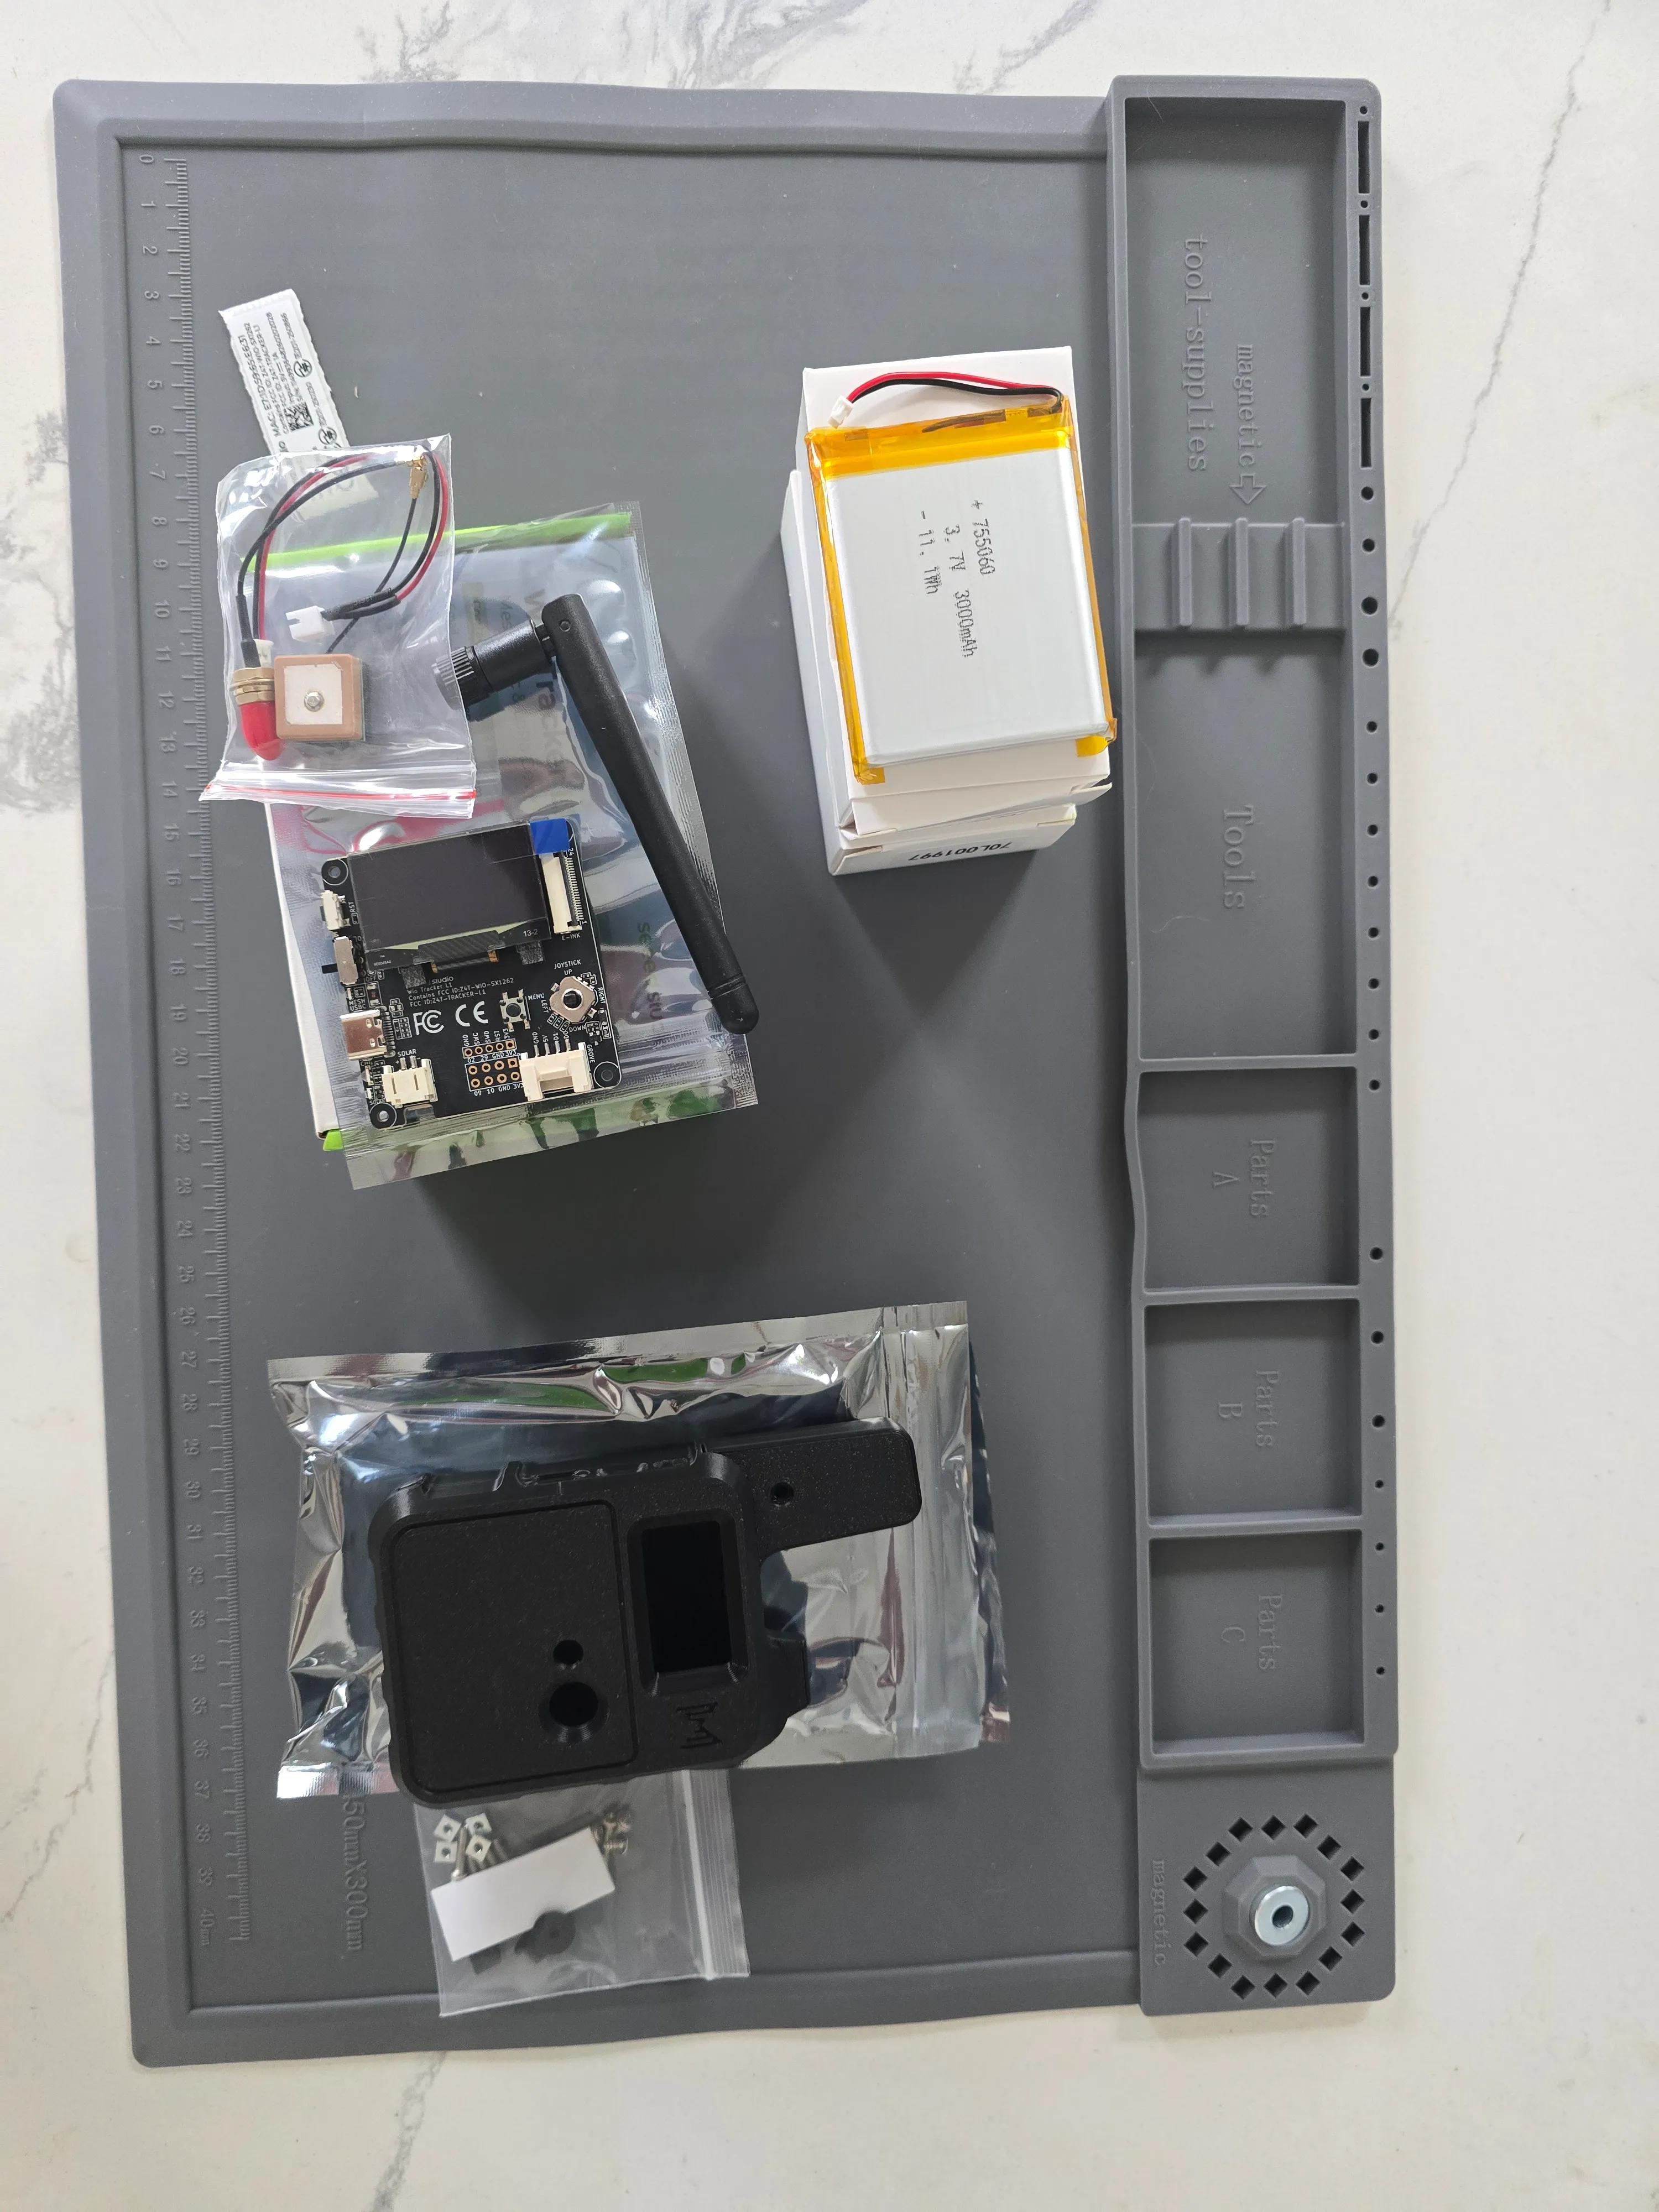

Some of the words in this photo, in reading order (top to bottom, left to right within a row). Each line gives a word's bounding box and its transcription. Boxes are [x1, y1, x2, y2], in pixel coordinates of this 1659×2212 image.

[139, 154, 155, 165] 0
[141, 201, 156, 209] 1
[143, 244, 158, 256] 2
[144, 289, 160, 301] 3
[145, 335, 161, 347] 4
[1181, 233, 1216, 472] tool-supplies
[147, 380, 164, 390] 5
[1231, 343, 1265, 466] magnetic
[148, 424, 165, 436] 6
[149, 469, 166, 482] 7
[151, 515, 168, 527] 8
[972, 518, 996, 576] 755060
[153, 559, 169, 570] 9
[154, 599, 170, 619] 10
[953, 588, 978, 659] 3000mAh
[155, 645, 172, 663] 11
[157, 690, 174, 709] 12
[159, 734, 176, 753] 13
[161, 780, 178, 799] 14
[163, 823, 180, 841] 15
[568, 847, 575, 856] 24
[907, 842, 1013, 861] 70L001997
[1222, 803, 1258, 911] Tools
[165, 868, 182, 886] 16
[167, 914, 184, 932] 17
[523, 928, 539, 937] 13-2
[561, 932, 581, 941] E-INK
[168, 958, 186, 975] 18
[554, 959, 582, 969] JOYSTICK
[408, 992, 436, 1001] Contains
[420, 984, 443, 993] Tracker
[528, 993, 545, 1001] MENU
[597, 987, 606, 1005] RIGHT
[348, 998, 366, 1006] MESH
[349, 1003, 367, 1011] USBC
[540, 999, 549, 1014] LEFT
[170, 1004, 187, 1022] 19
[455, 1000, 489, 1027] CE
[483, 1030, 492, 1044] SWD
[502, 1027, 511, 1040] 3V3
[568, 1024, 587, 1033] DOWN
[531, 1031, 540, 1045] GND
[541, 1034, 549, 1042] 5V
[172, 1046, 189, 1066] 20
[397, 1048, 418, 1057] SOLAR
[505, 1049, 517, 1057] 3V3
[586, 1044, 596, 1063] GROVE
[498, 1084, 512, 1092] GND
[174, 1091, 191, 1110] 21
[174, 1133, 191, 1152] 22
[175, 1177, 193, 1196] 23
[1211, 1171, 1240, 1188] A
[1248, 1138, 1276, 1218] Parts
[178, 1219, 193, 1238] 24
[179, 1264, 195, 1284] 25
[179, 1306, 196, 1326] 26
[180, 1350, 198, 1369] 27
[181, 1392, 199, 1413] 28
[1217, 1401, 1244, 1420] B
[1254, 1369, 1280, 1448] Parts
[183, 1437, 200, 1457] 29
[185, 1480, 201, 1499] 30
[187, 1523, 203, 1541] 31
[188, 1566, 205, 1585] 32
[190, 1609, 207, 1628] 33
[1222, 1625, 1245, 1644] C
[1257, 1593, 1284, 1671] Parts
[190, 1654, 207, 1673] 34
[191, 1696, 208, 1715] 35
[194, 1739, 209, 1759] 36
[194, 1780, 210, 1799] 37
[195, 1823, 211, 1844] 38
[197, 1867, 213, 1886] 39
[1150, 1858, 1171, 1966] magnetic
